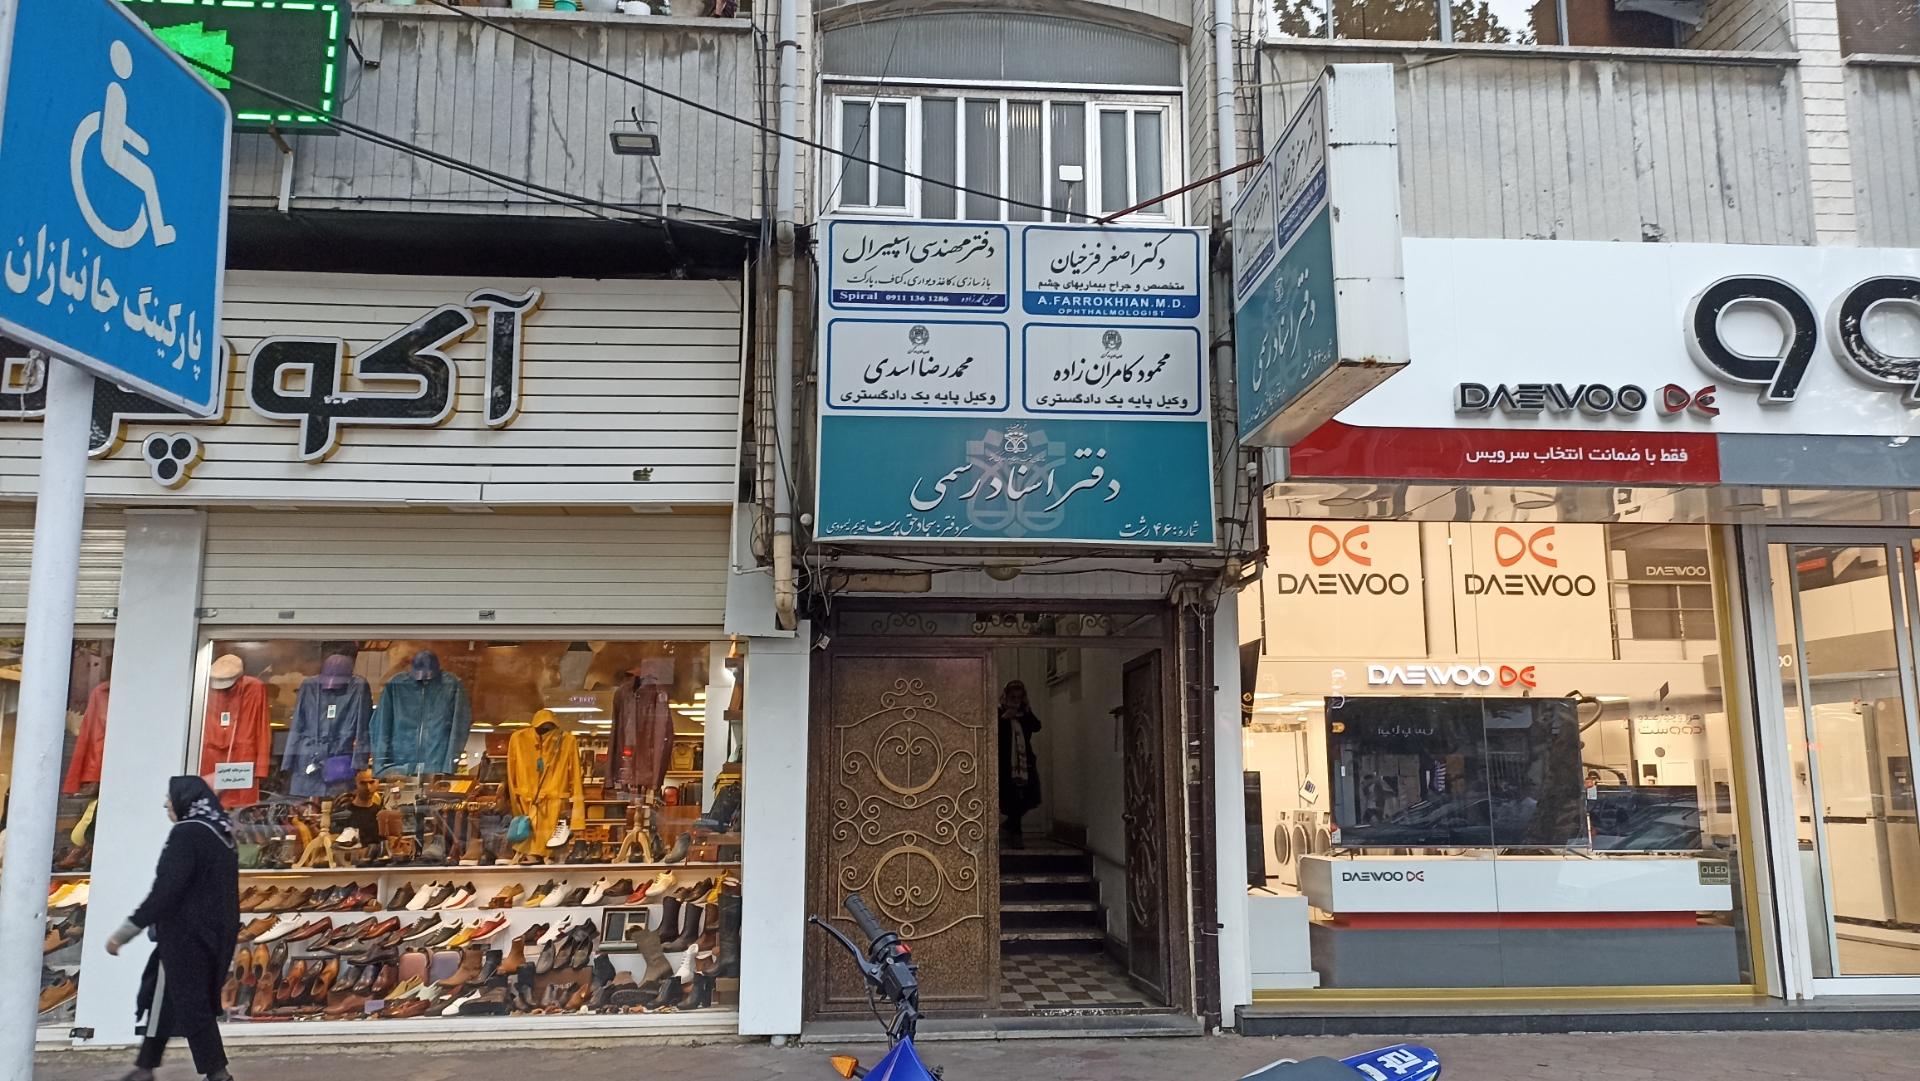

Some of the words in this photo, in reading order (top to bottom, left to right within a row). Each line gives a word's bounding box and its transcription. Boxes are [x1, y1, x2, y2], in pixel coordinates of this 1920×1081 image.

[842, 234, 910, 263] اسپیرال
[910, 238, 971, 263] مهندسی
[956, 230, 995, 263] دفتر
[1130, 233, 1172, 275] دکتر
[1098, 245, 1135, 274] اصغر
[4, 224, 119, 332] جانبازان
[1038, 279, 1060, 290] چشم
[1109, 280, 1131, 292] جراح
[1134, 282, 1140, 291] و
[1143, 281, 1185, 292] متخصص
[839, 291, 878, 303] Spiral
[886, 294, 907, 302] 0911
[929, 295, 949, 303] 1286
[1058, 308, 1165, 317] OPHTHALMOLOGIST
[123, 287, 201, 381] پارکینگ
[863, 357, 915, 384] اسدی
[1137, 353, 1171, 383] محمود
[840, 389, 907, 403] دادگستری
[910, 391, 930, 404] یک
[934, 390, 960, 404] پایه
[963, 390, 996, 405] وکیل
[1036, 393, 1101, 407] دادگستری
[1104, 394, 1124, 408] یک
[1127, 394, 1153, 408] پایه
[1156, 395, 1188, 409] وکیل
[1455, 382, 1648, 420] DAEWOO
[1466, 449, 1530, 464] سرویس
[1533, 446, 1583, 464] انتخاب
[1588, 447, 1640, 462] ضمانت
[1645, 448, 1656, 466] با
[1660, 448, 1688, 462] فقط
[909, 463, 981, 511] رسمی
[985, 464, 1055, 501] اسناد
[1043, 447, 1121, 513] دفتر
[916, 516, 937, 537] سجاد
[1119, 515, 1151, 537] رشت
[1646, 566, 1707, 577] DAEWOO
[1278, 573, 1410, 595] DAEWOO
[1465, 574, 1596, 597] DAEWOO
[1367, 665, 1495, 687] DAEWOO
[1341, 871, 1404, 882] DAEWOO
[1701, 865, 1728, 874] OLED
